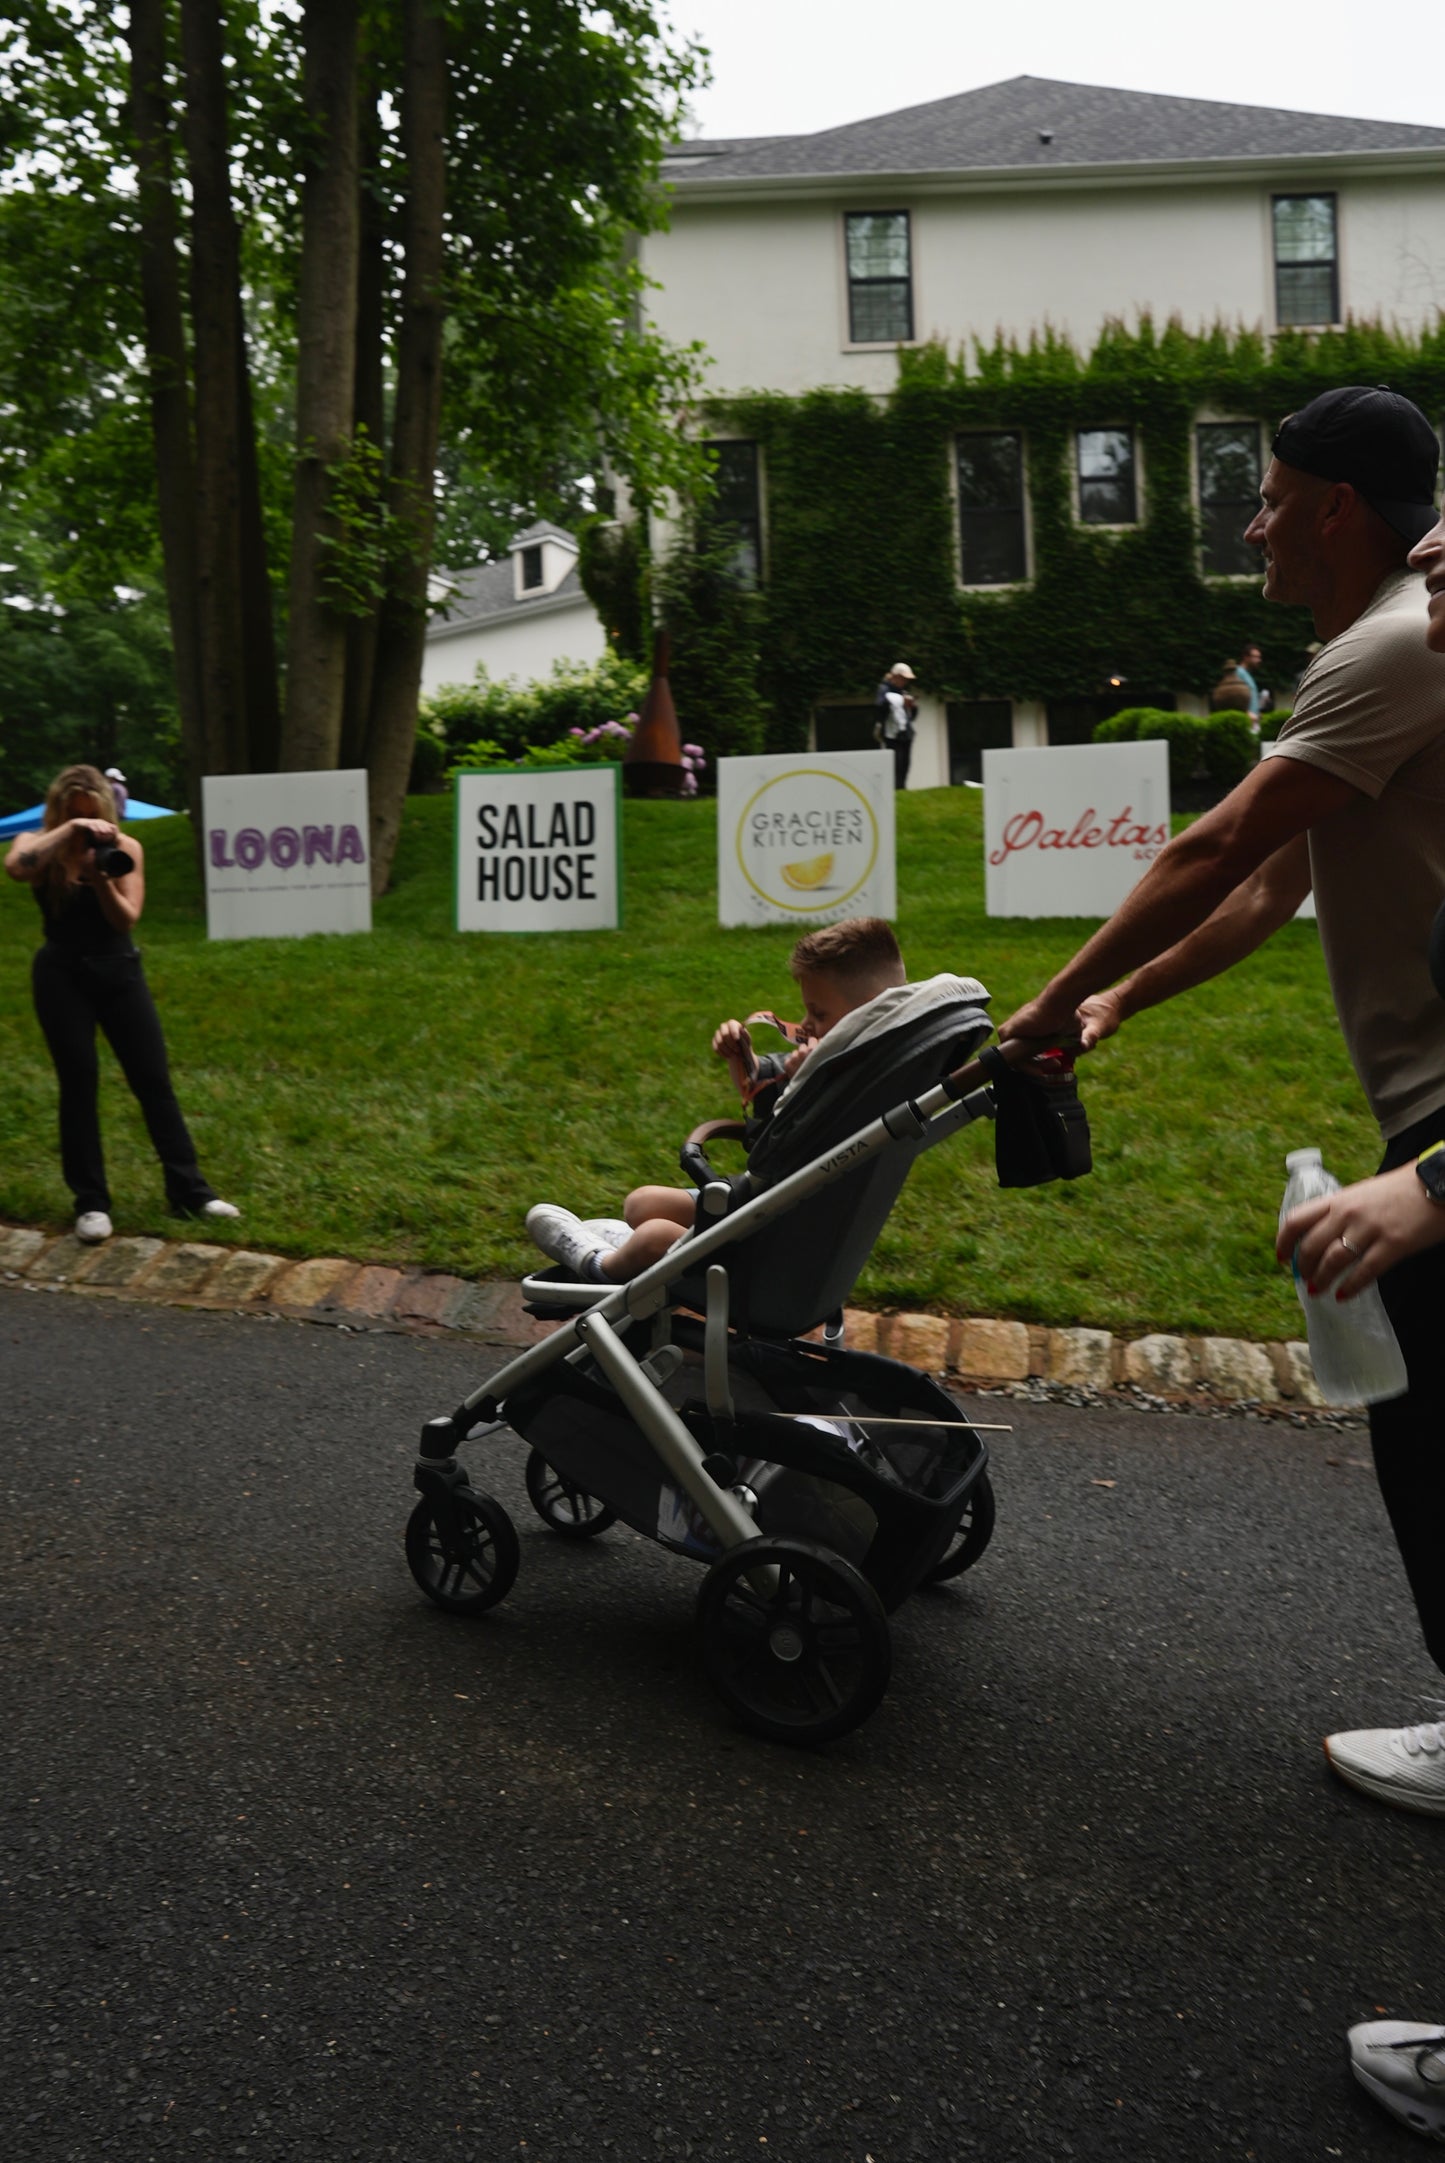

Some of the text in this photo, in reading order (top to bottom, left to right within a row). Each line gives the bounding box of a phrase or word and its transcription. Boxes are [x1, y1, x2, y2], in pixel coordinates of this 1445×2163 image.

[477, 801, 596, 850] SALAD
[751, 808, 863, 830] GRACIE'S
[753, 828, 862, 848] KITCHEN
[990, 805, 1167, 866] Paletas
[209, 824, 366, 870] LOONA
[477, 854, 597, 901] HOUSE
[820, 1140, 869, 1172] VISTA
